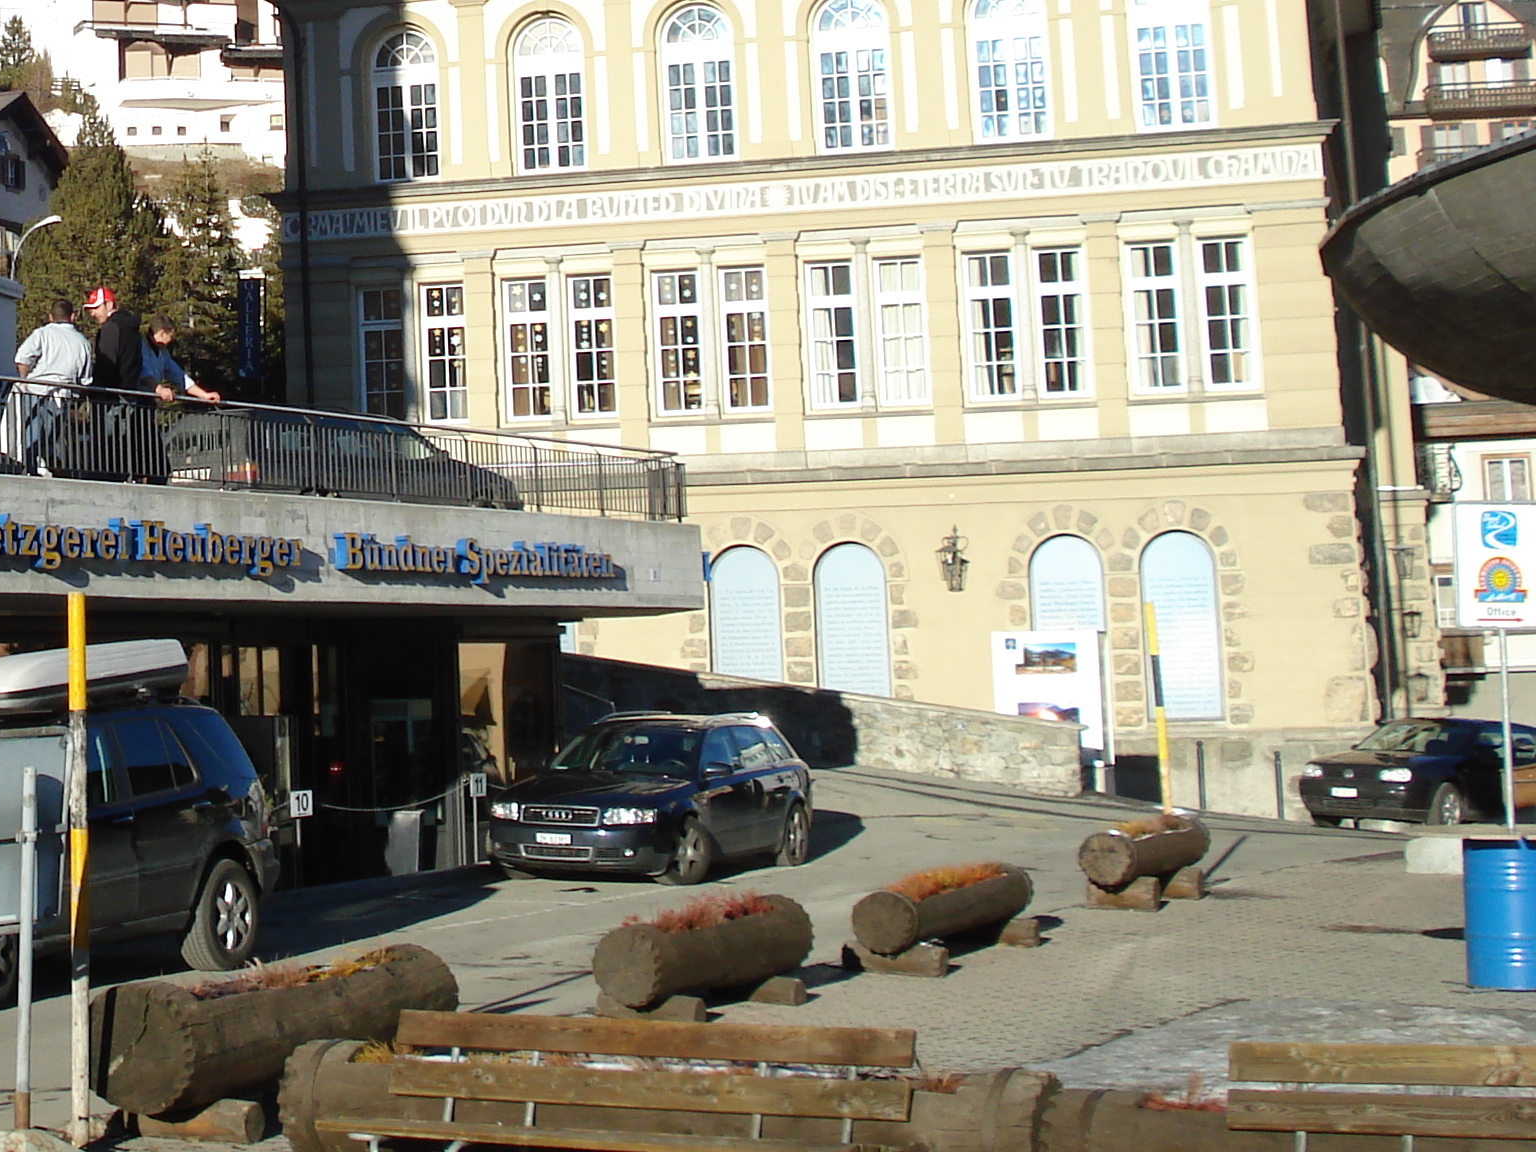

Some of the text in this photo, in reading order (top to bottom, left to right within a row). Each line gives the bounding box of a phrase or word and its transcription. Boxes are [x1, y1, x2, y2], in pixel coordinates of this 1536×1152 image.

[904, 171, 985, 198] ETERNA
[243, 280, 255, 371] GALLERIA
[132, 519, 303, 577] Heuberger
[336, 532, 616, 584] Bündner Spezialitäten
[1486, 606, 1517, 617] Office
[474, 777, 484, 794] 11
[295, 792, 309, 812] 10
